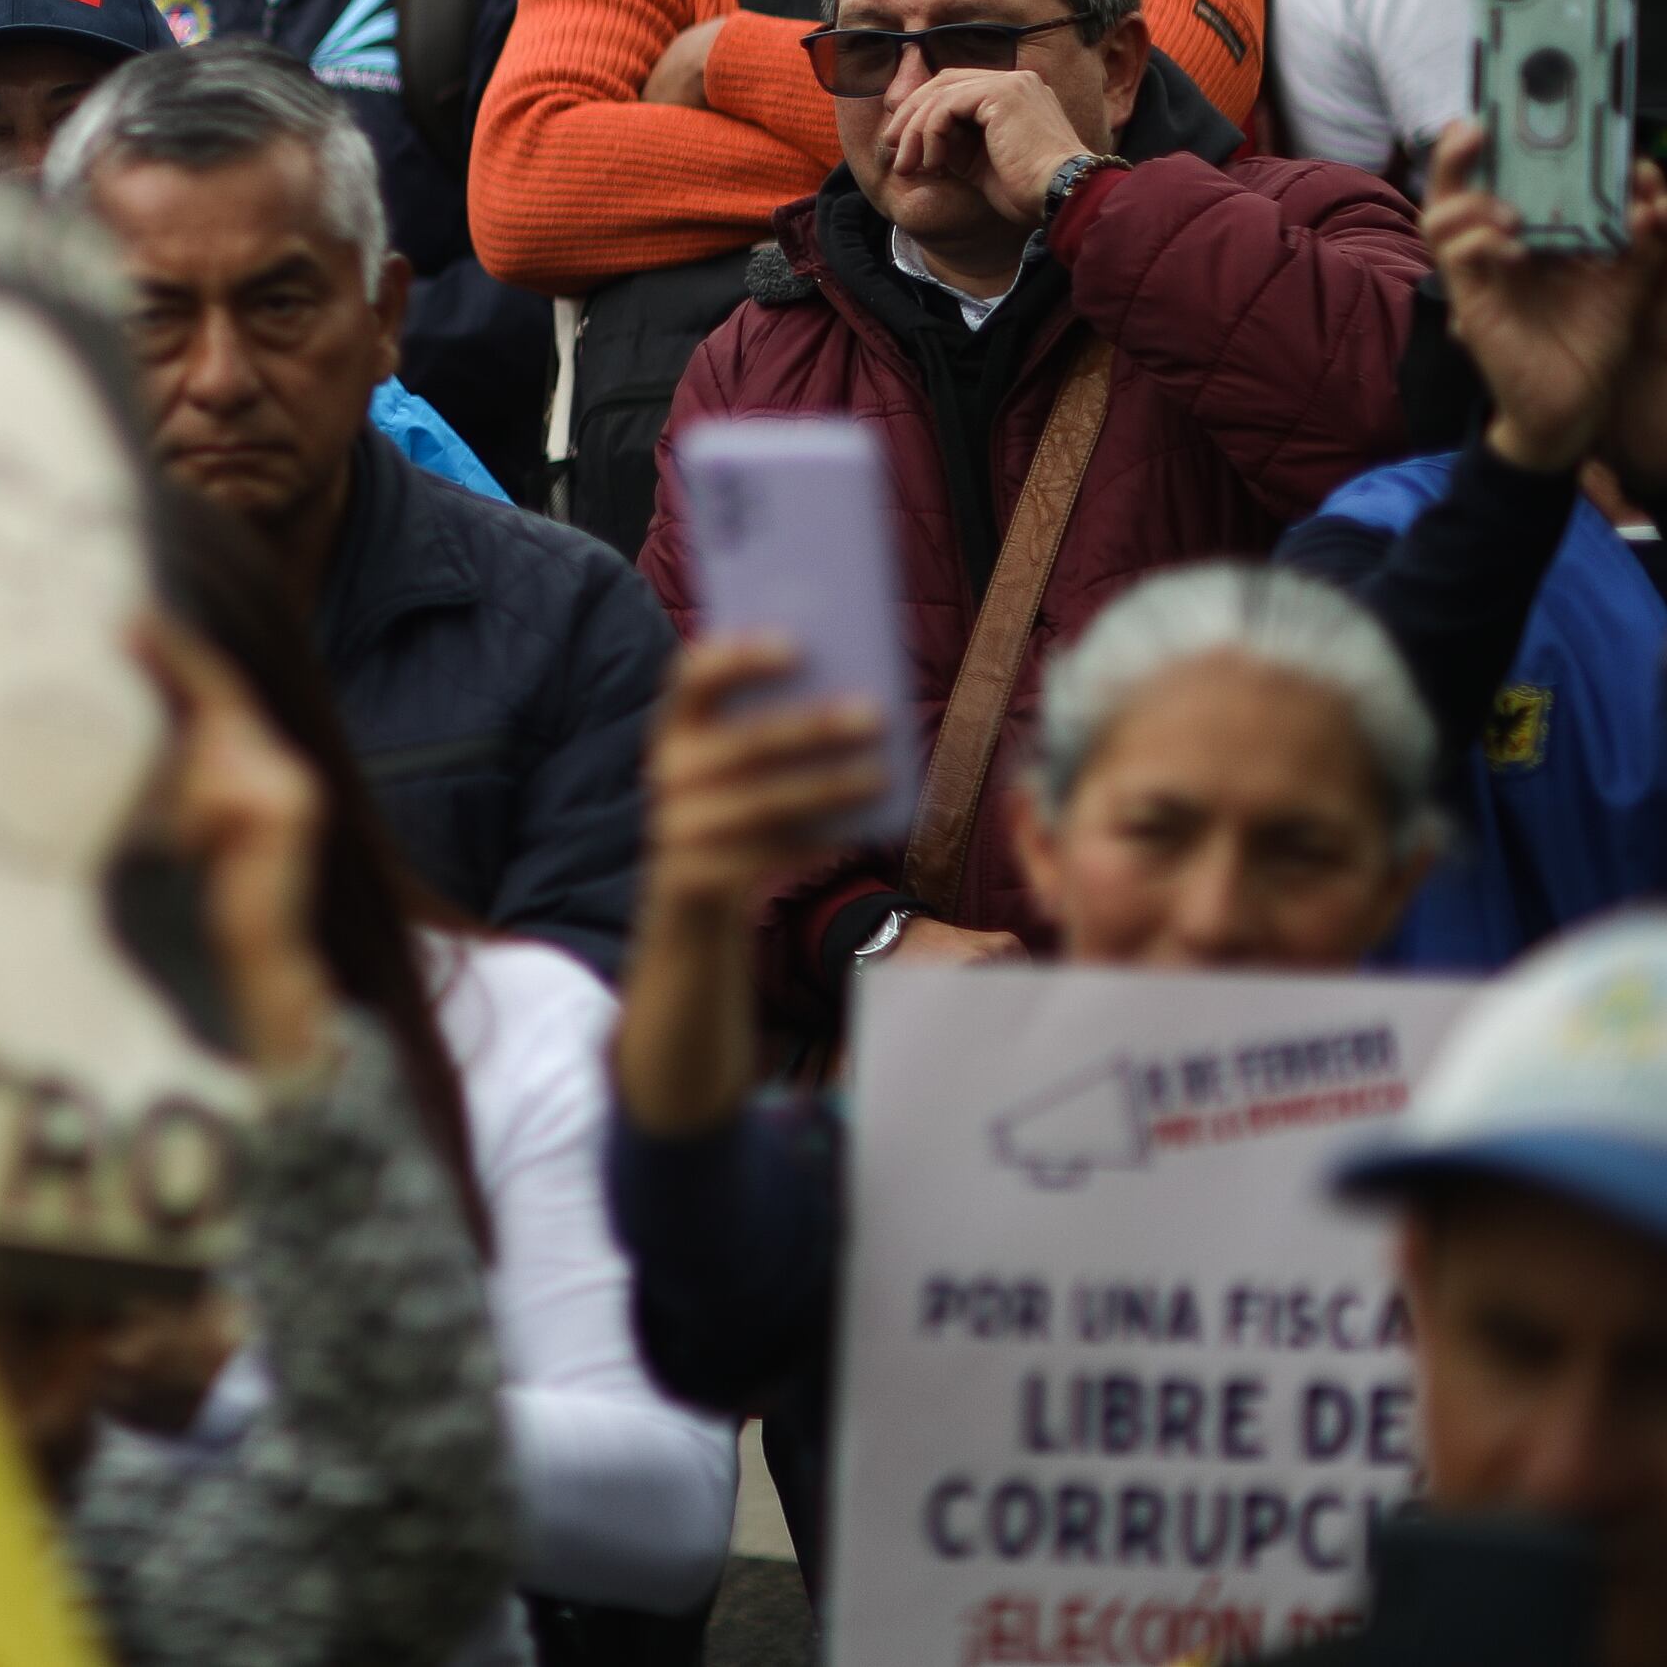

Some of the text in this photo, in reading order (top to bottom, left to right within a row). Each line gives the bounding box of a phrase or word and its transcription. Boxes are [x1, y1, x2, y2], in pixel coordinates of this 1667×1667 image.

[922, 1277, 1050, 1338] POR
[1077, 1282, 1201, 1342] UNA
[1021, 1375, 1414, 1465] LIBRE DE
